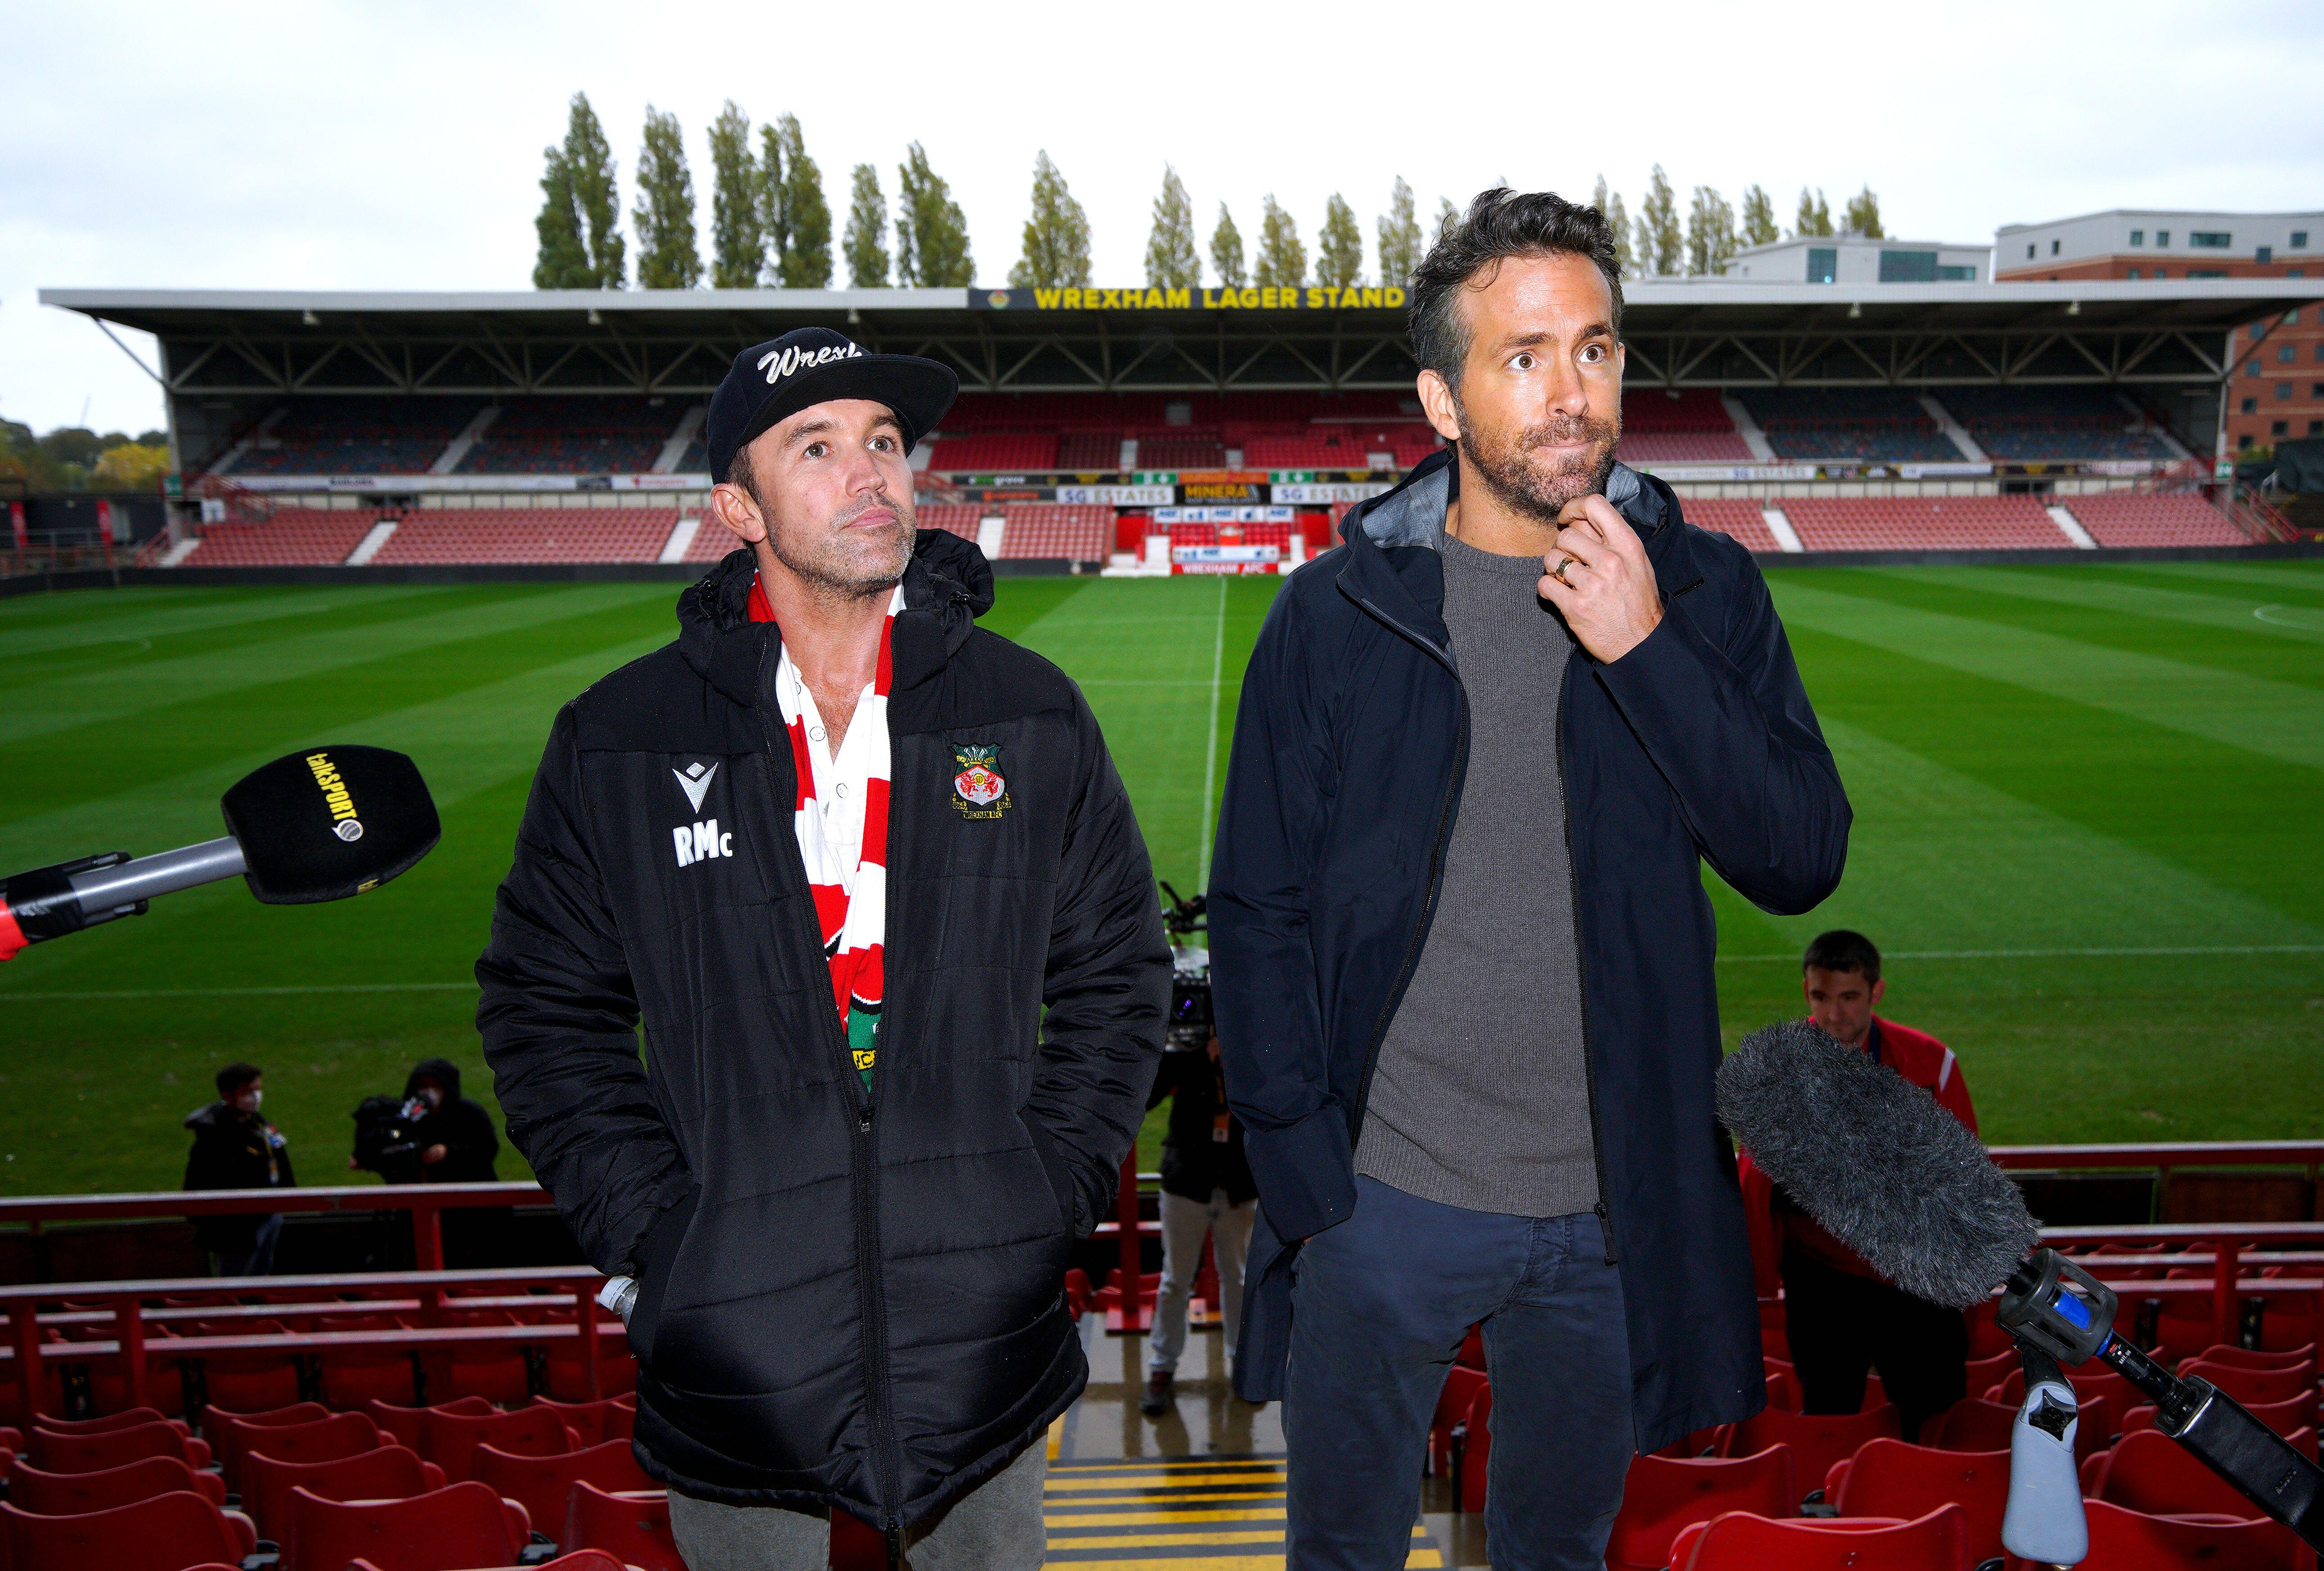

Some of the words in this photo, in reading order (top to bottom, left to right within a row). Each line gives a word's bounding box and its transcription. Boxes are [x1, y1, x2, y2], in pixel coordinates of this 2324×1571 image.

[1034, 288, 1191, 309] WREXHAM
[1203, 287, 1298, 309] LAGER
[1307, 287, 1405, 308] STAND
[1065, 490, 1086, 503] SG
[1094, 489, 1167, 502] ESTATES
[1184, 485, 1249, 498] MINERA
[1281, 489, 1302, 500] SG
[1182, 563, 1238, 575] WREXHAM
[306, 753, 357, 820] talkSPORT
[673, 819, 733, 867] RMc
